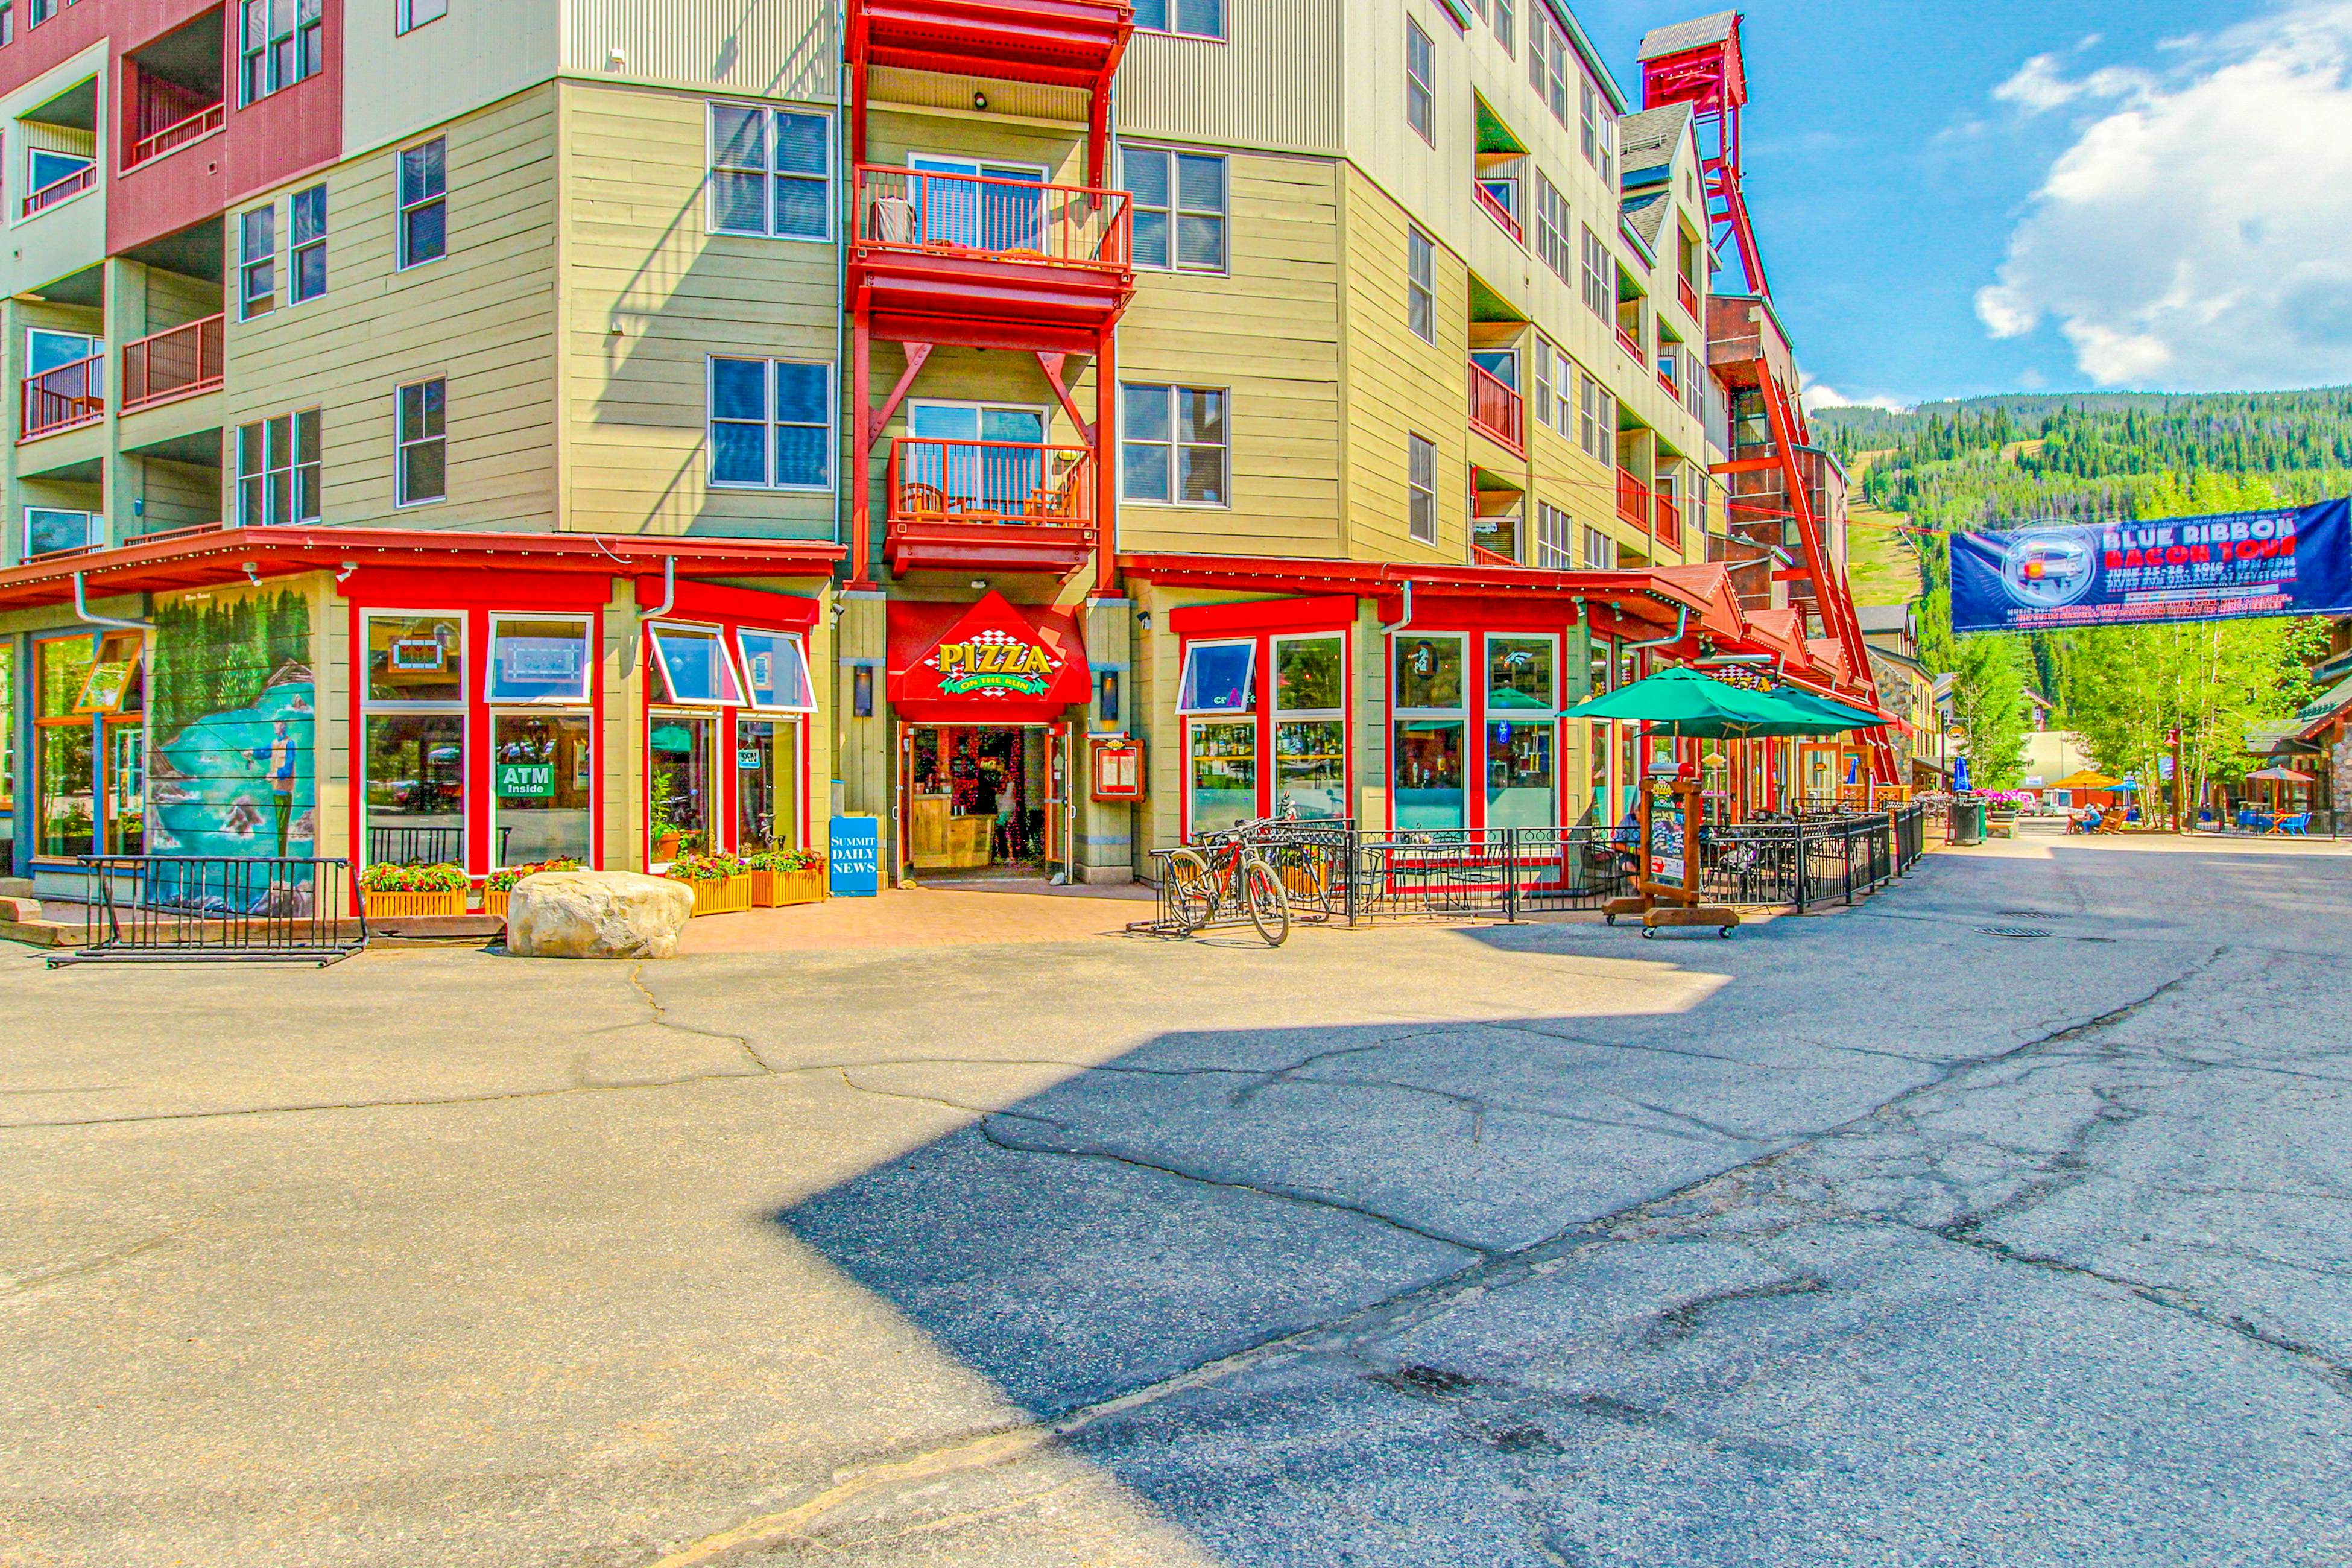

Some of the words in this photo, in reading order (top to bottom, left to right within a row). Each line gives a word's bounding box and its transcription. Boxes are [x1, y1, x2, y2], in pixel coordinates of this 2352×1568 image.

[2102, 527, 2174, 551] BLUE
[2182, 518, 2297, 545] RIBBON
[2105, 544, 2210, 569] BACON
[2218, 536, 2297, 561] TOUR
[2106, 567, 2140, 577] JUNE
[2192, 561, 2224, 572] 2016
[938, 644, 1053, 674] PIZZA
[960, 680, 978, 690] ON
[1005, 677, 1029, 691] RUN
[503, 768, 549, 783] ATM
[508, 784, 544, 793] Inside
[831, 836, 876, 847] SUMMIT
[832, 849, 876, 859] DAILY
[832, 862, 876, 873] NEWS
